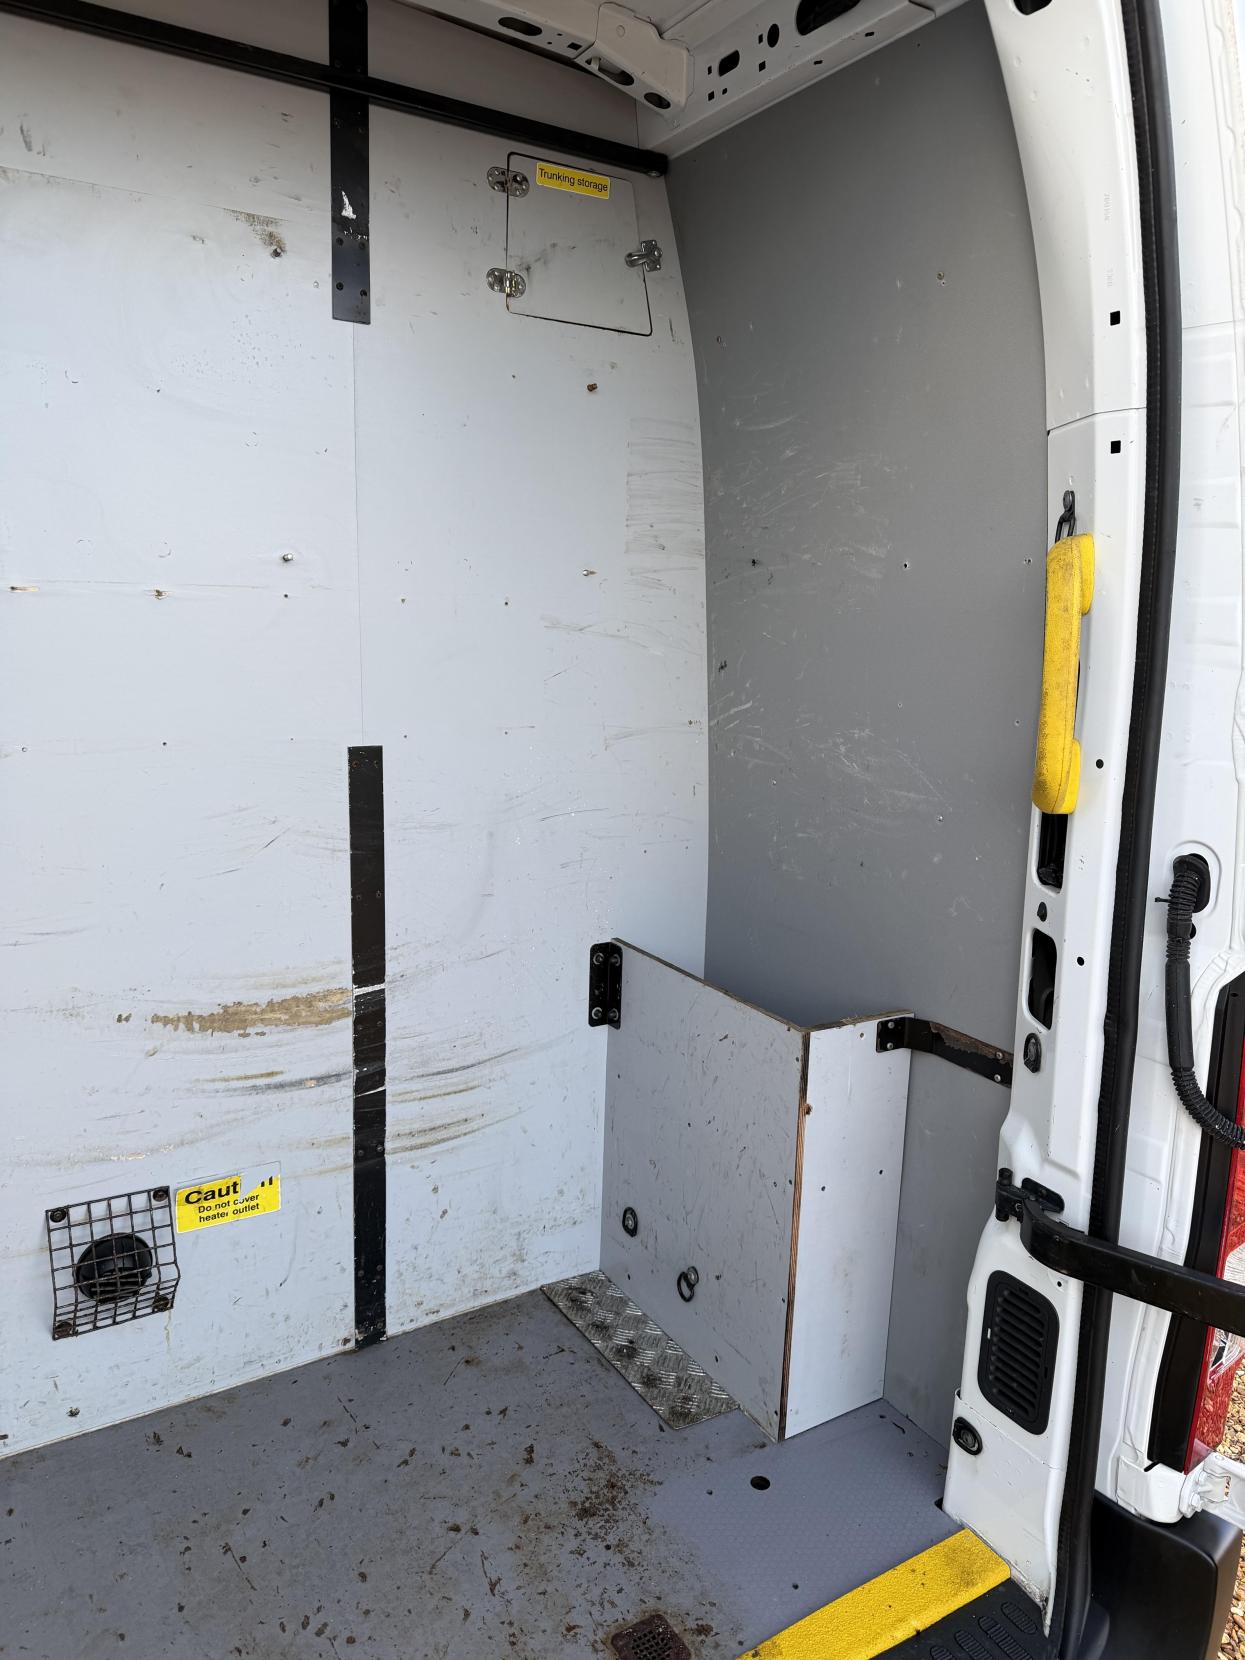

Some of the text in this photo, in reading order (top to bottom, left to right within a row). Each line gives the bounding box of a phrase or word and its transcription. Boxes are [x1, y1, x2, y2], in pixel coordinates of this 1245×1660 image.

[539, 168, 608, 192] Trunking storage
[198, 1205, 212, 1213] Do
[214, 1201, 231, 1210] not
[199, 1203, 259, 1222] heater outlet
